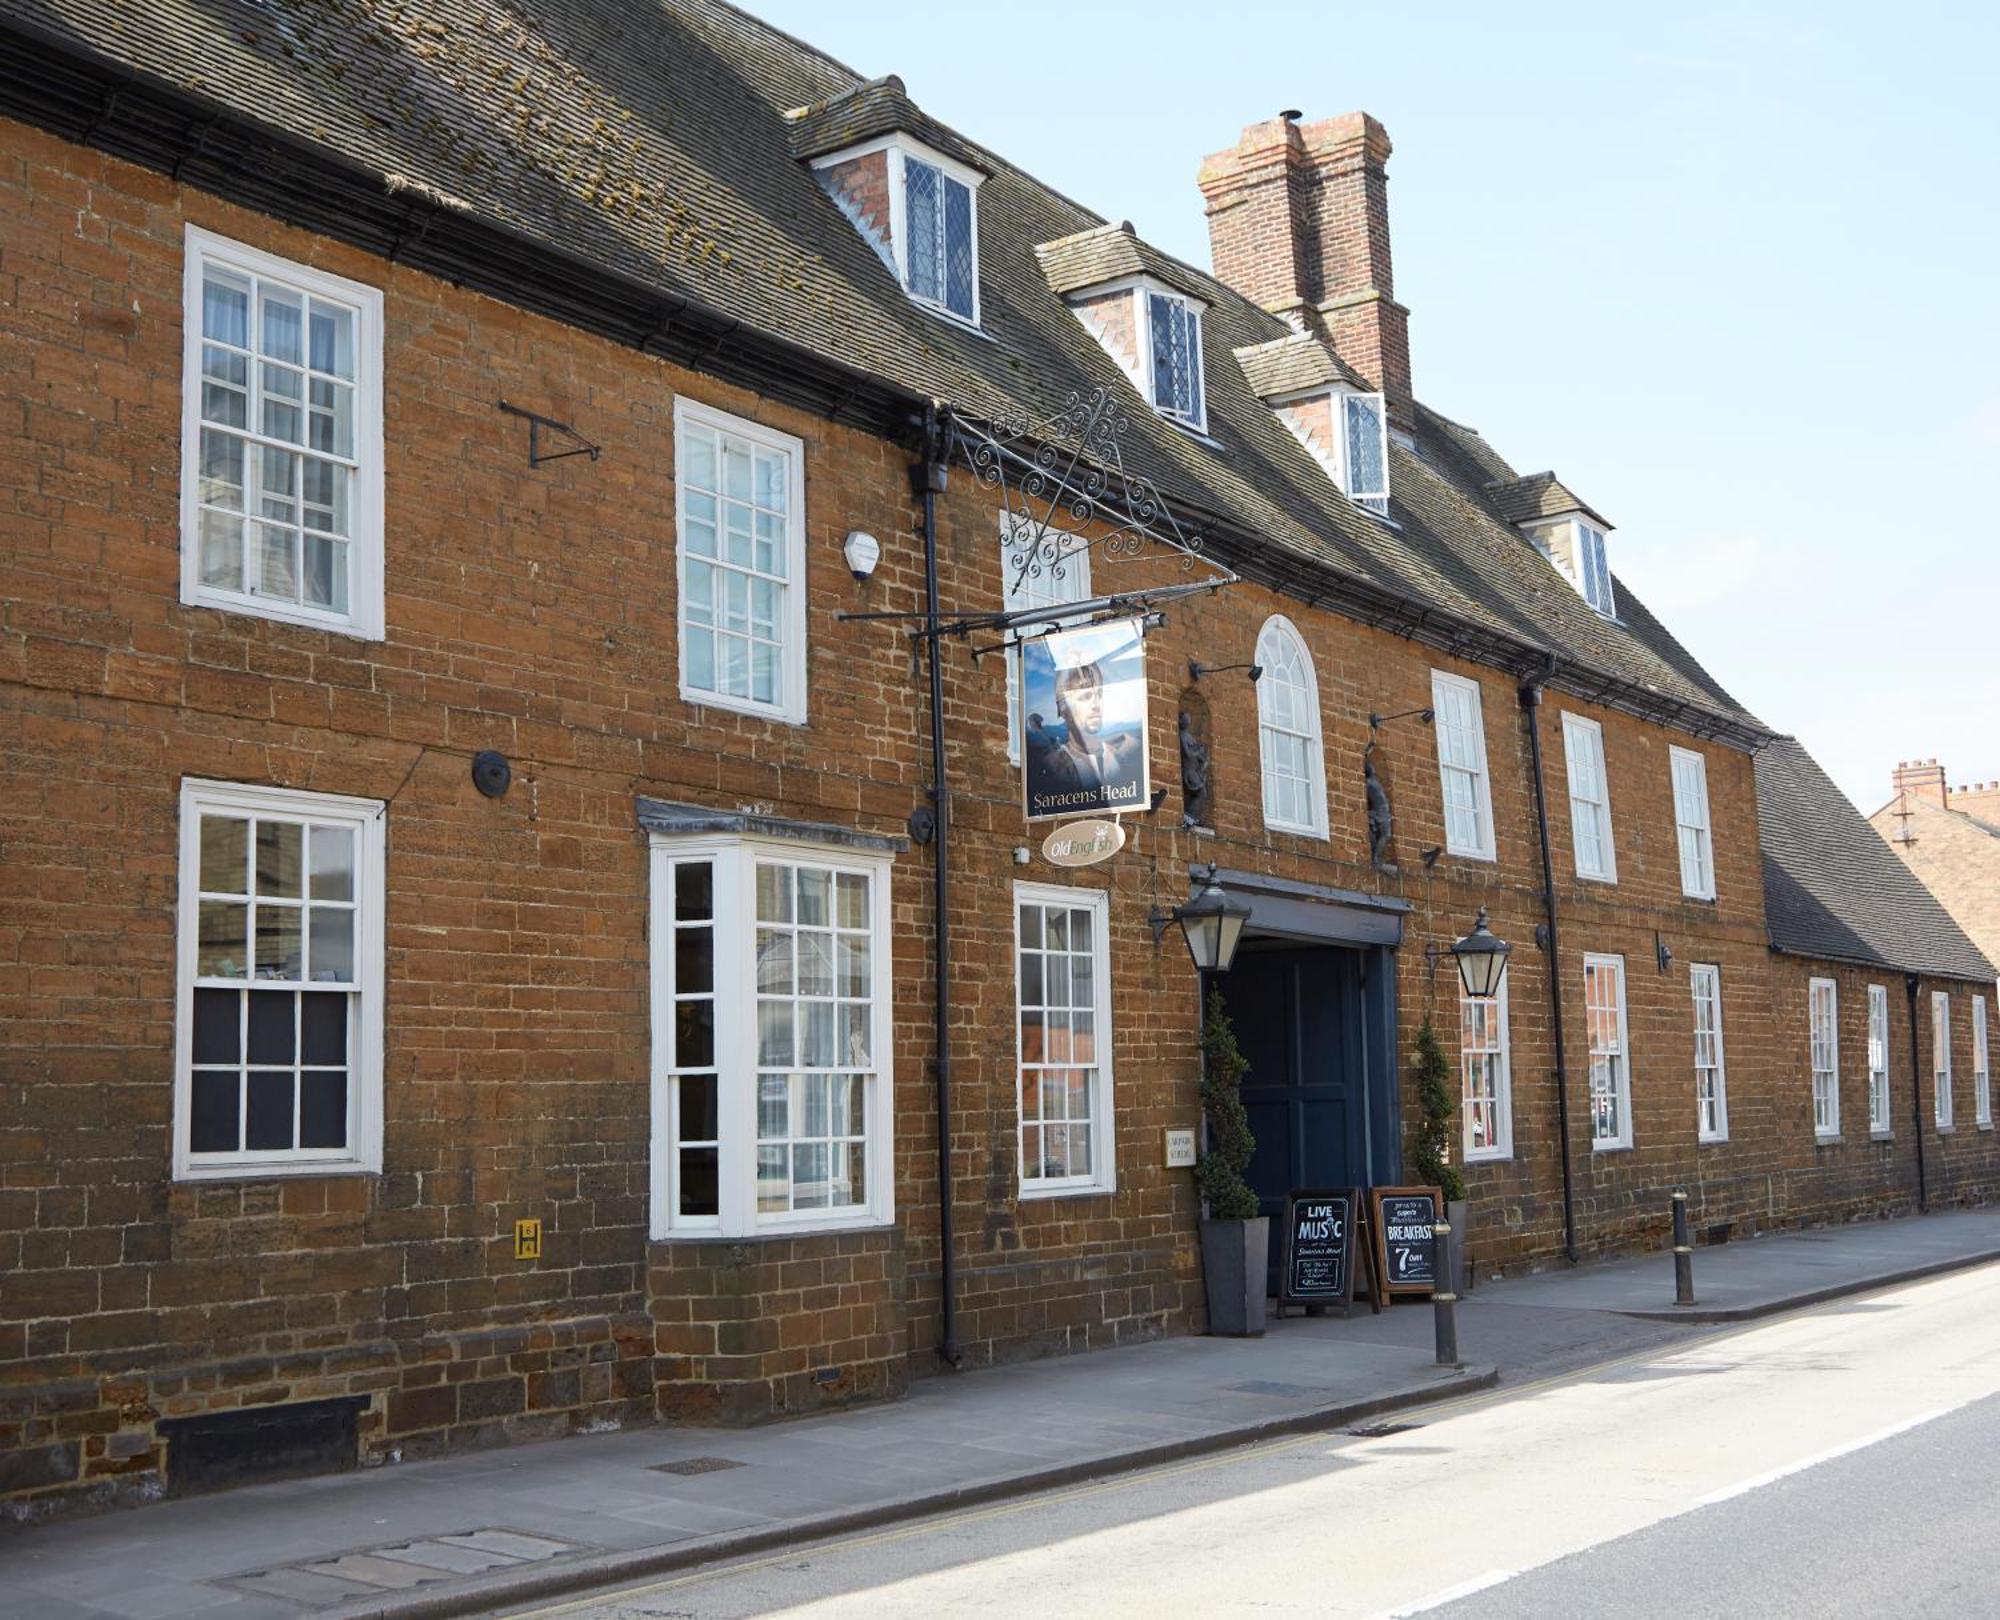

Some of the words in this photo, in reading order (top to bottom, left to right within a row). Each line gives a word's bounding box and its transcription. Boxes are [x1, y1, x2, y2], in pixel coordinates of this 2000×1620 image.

[1033, 788, 1097, 809] Saracens
[1100, 781, 1137, 801] Head
[1307, 1205, 1333, 1217] LIVE
[1298, 1219, 1342, 1240] MUSIC
[1387, 1225, 1432, 1241] BREAKFAST
